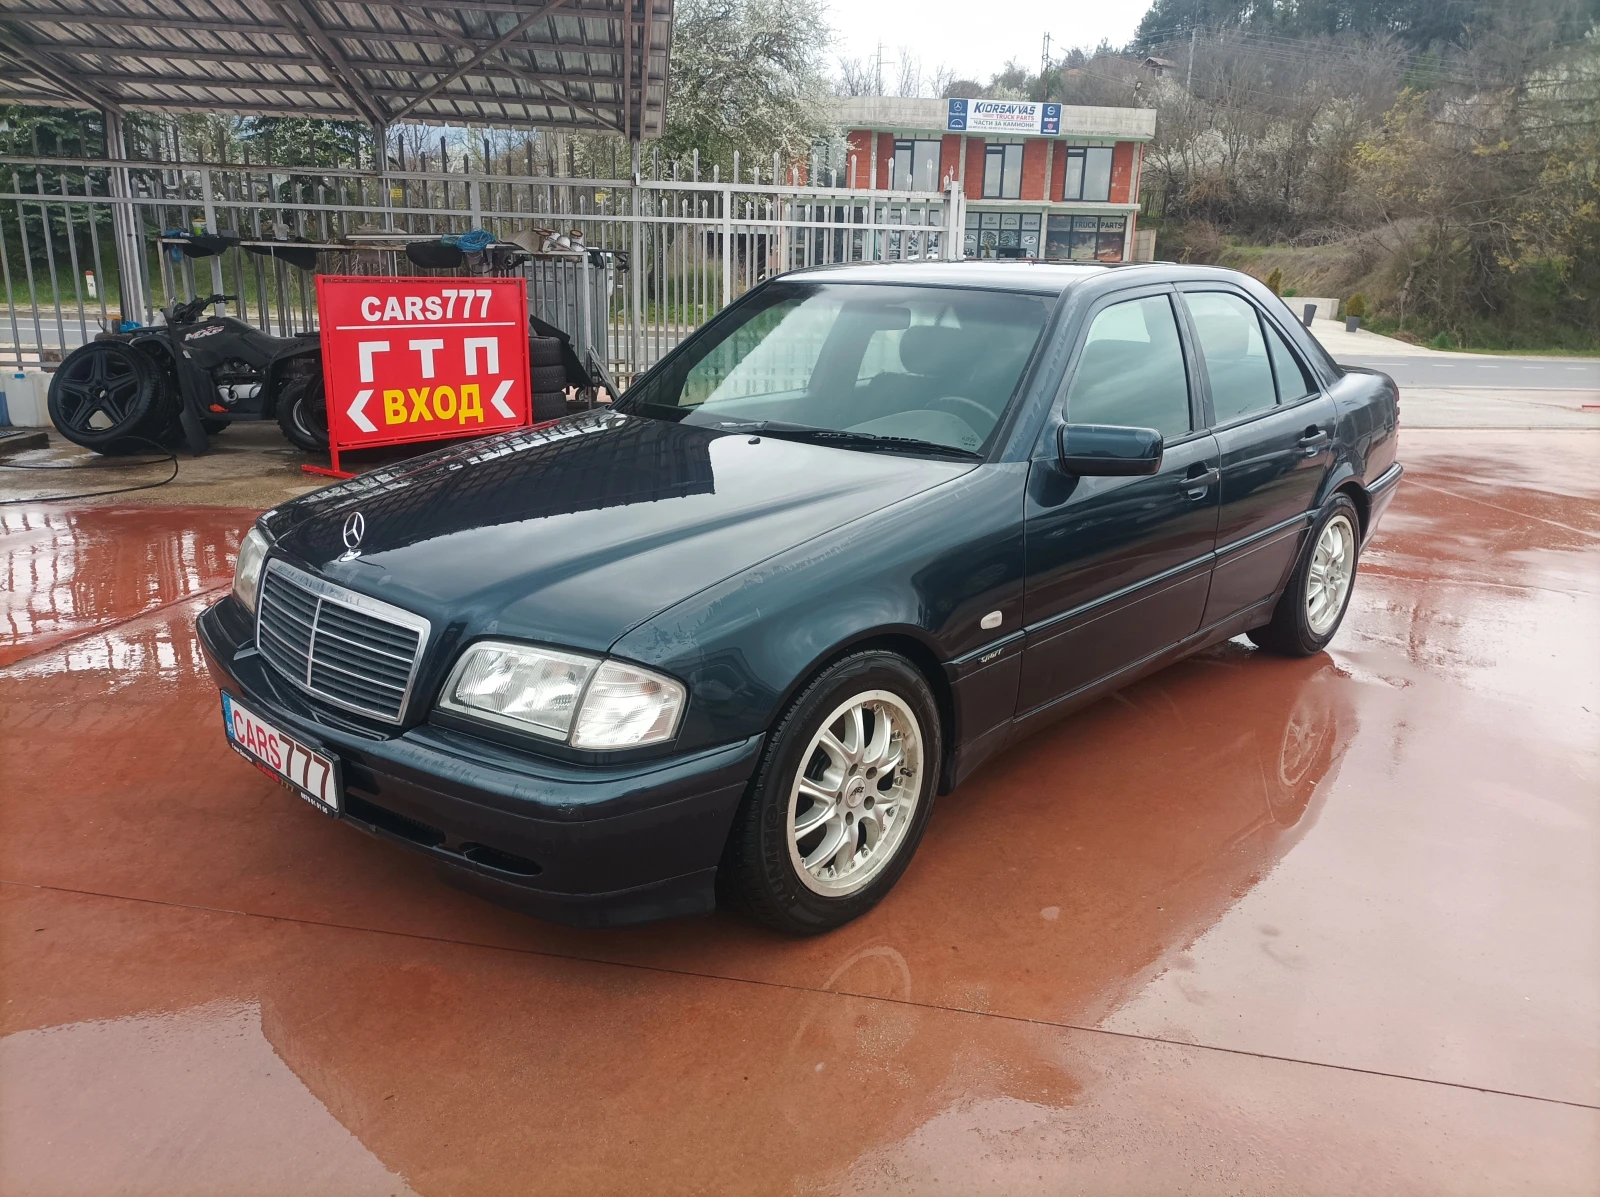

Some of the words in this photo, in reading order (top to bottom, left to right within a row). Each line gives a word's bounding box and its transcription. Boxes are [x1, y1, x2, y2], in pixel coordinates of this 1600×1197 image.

[974, 102, 1036, 115] KIORSAVVAS
[361, 289, 492, 322] CARS777
[383, 384, 484, 425] ВХОД
[233, 709, 331, 801] CARS777
